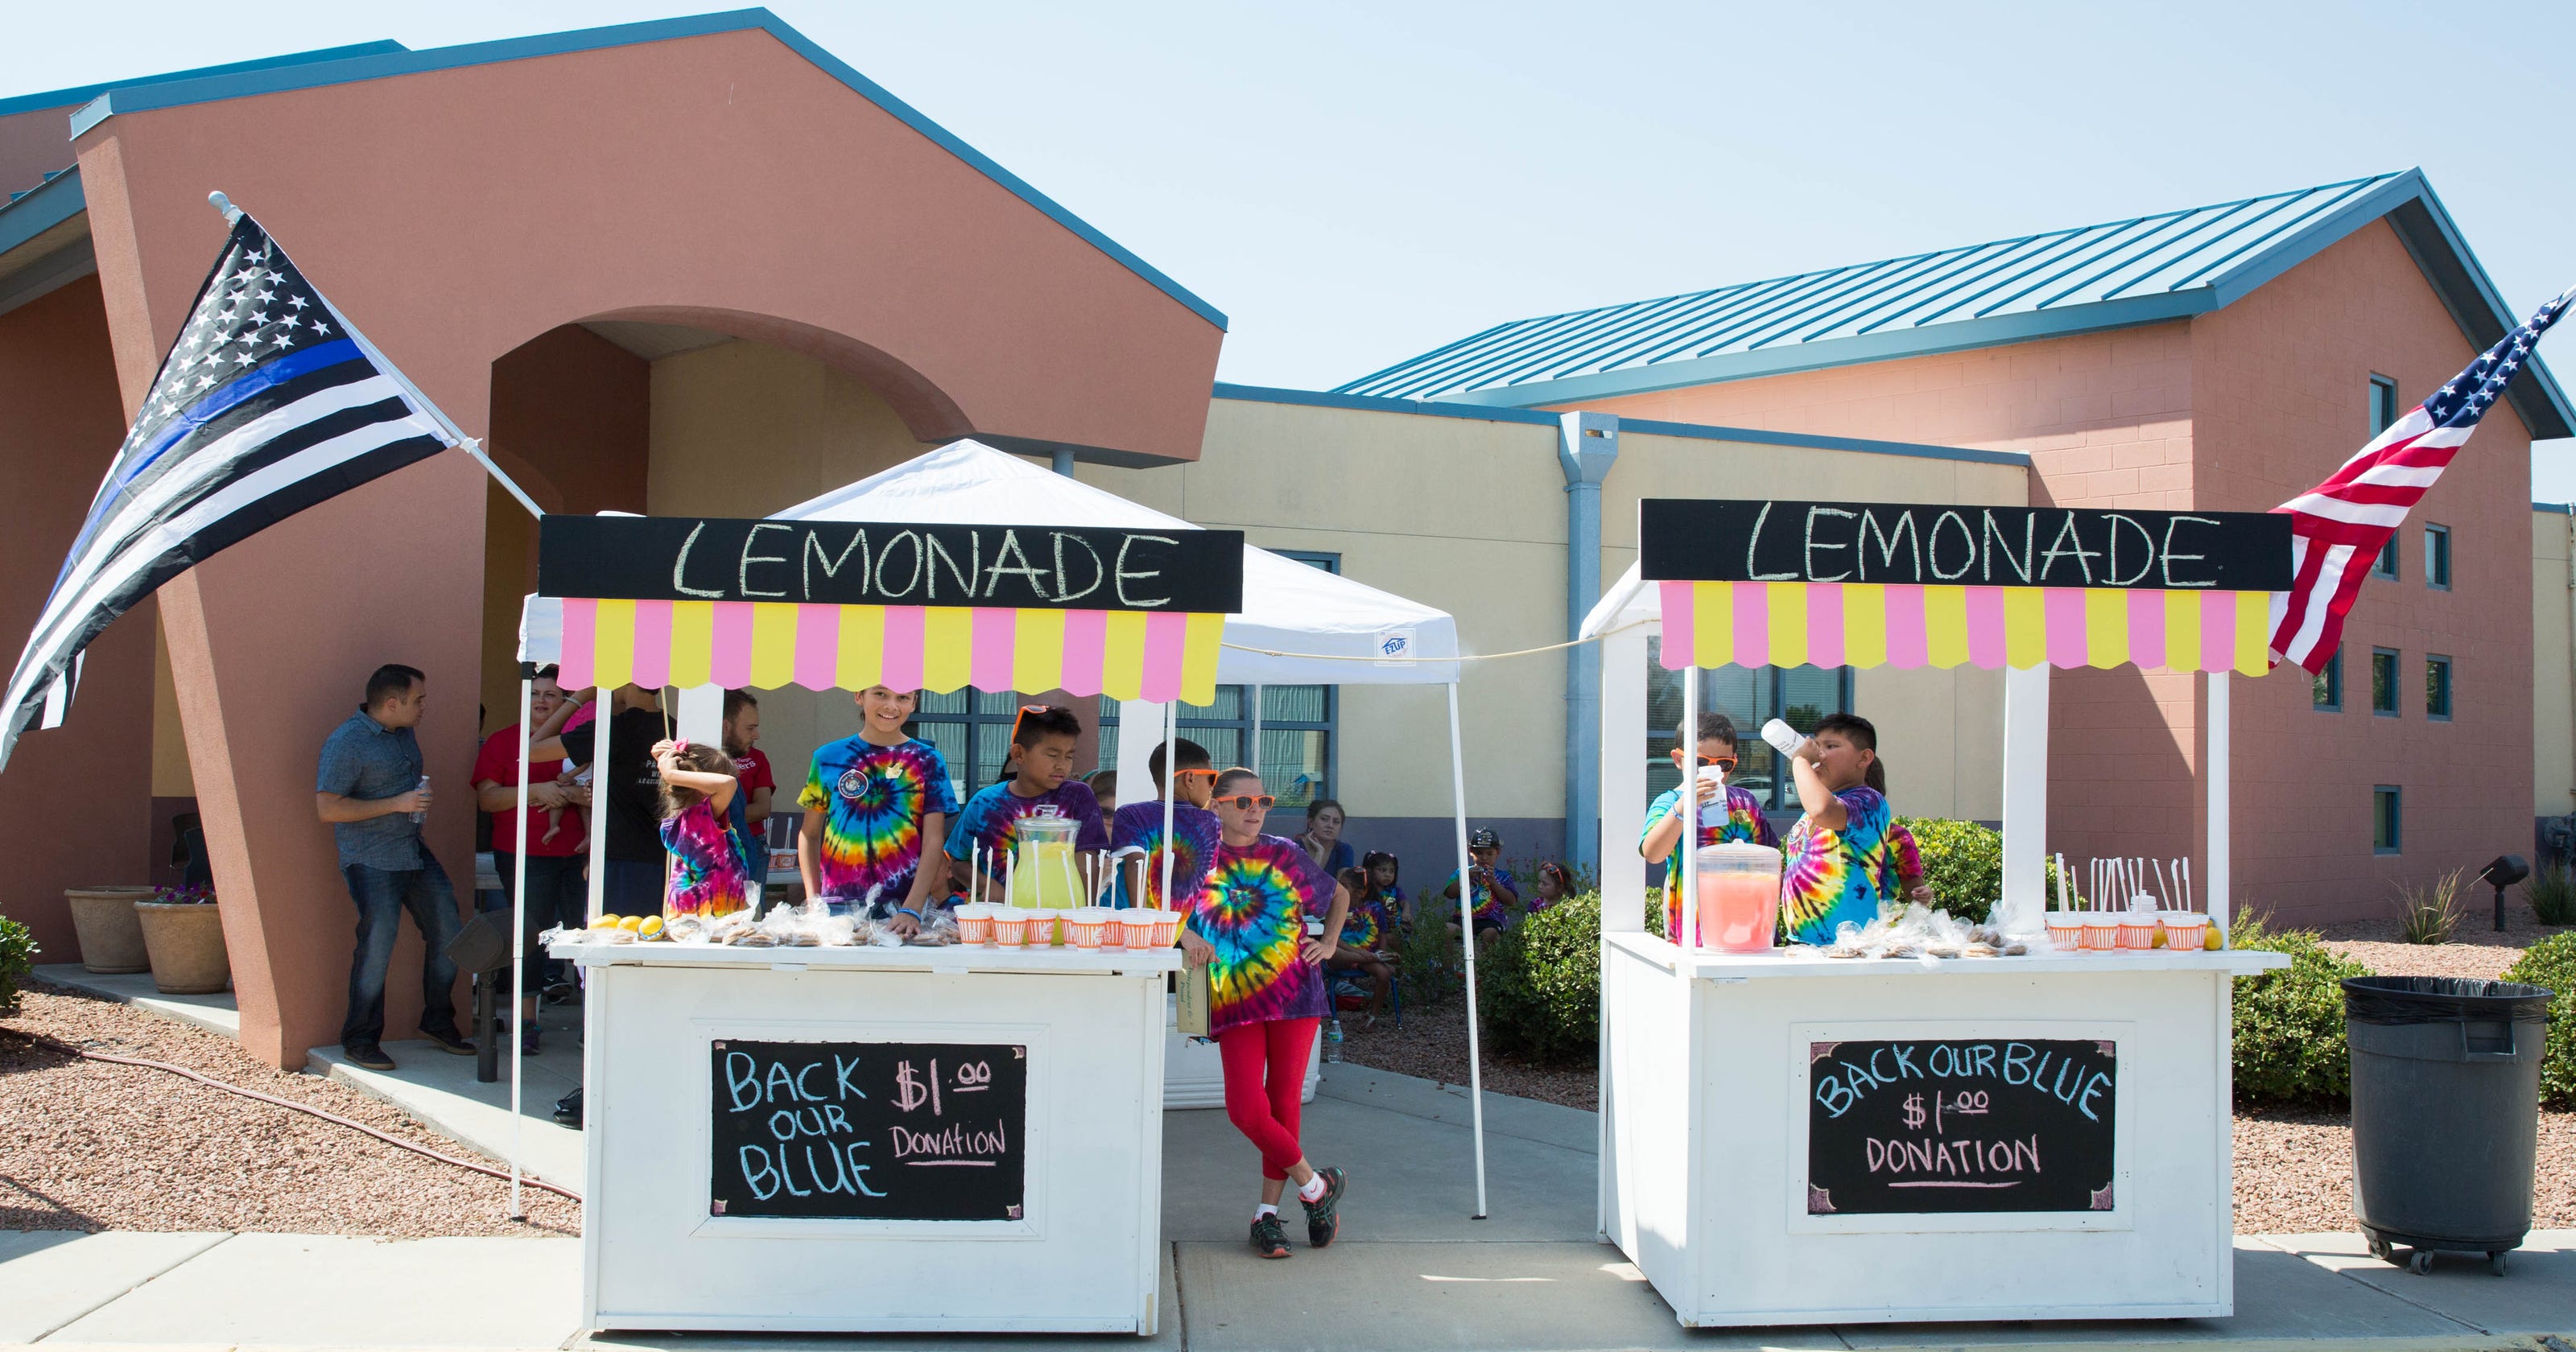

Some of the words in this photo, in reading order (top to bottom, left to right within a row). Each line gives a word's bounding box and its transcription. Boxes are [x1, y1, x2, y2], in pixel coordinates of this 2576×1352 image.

[672, 520, 1179, 607] LEMONADE
[1746, 501, 2221, 587] LEMONADE
[726, 1051, 868, 1113] BACK
[1816, 1044, 1924, 1119] BACK
[1930, 1044, 1996, 1078] OUR
[2003, 1043, 2113, 1123] BLUE
[767, 1104, 853, 1141] OUR
[739, 1139, 888, 1201] BLUE
[1866, 1133, 2041, 1176] DONATION
